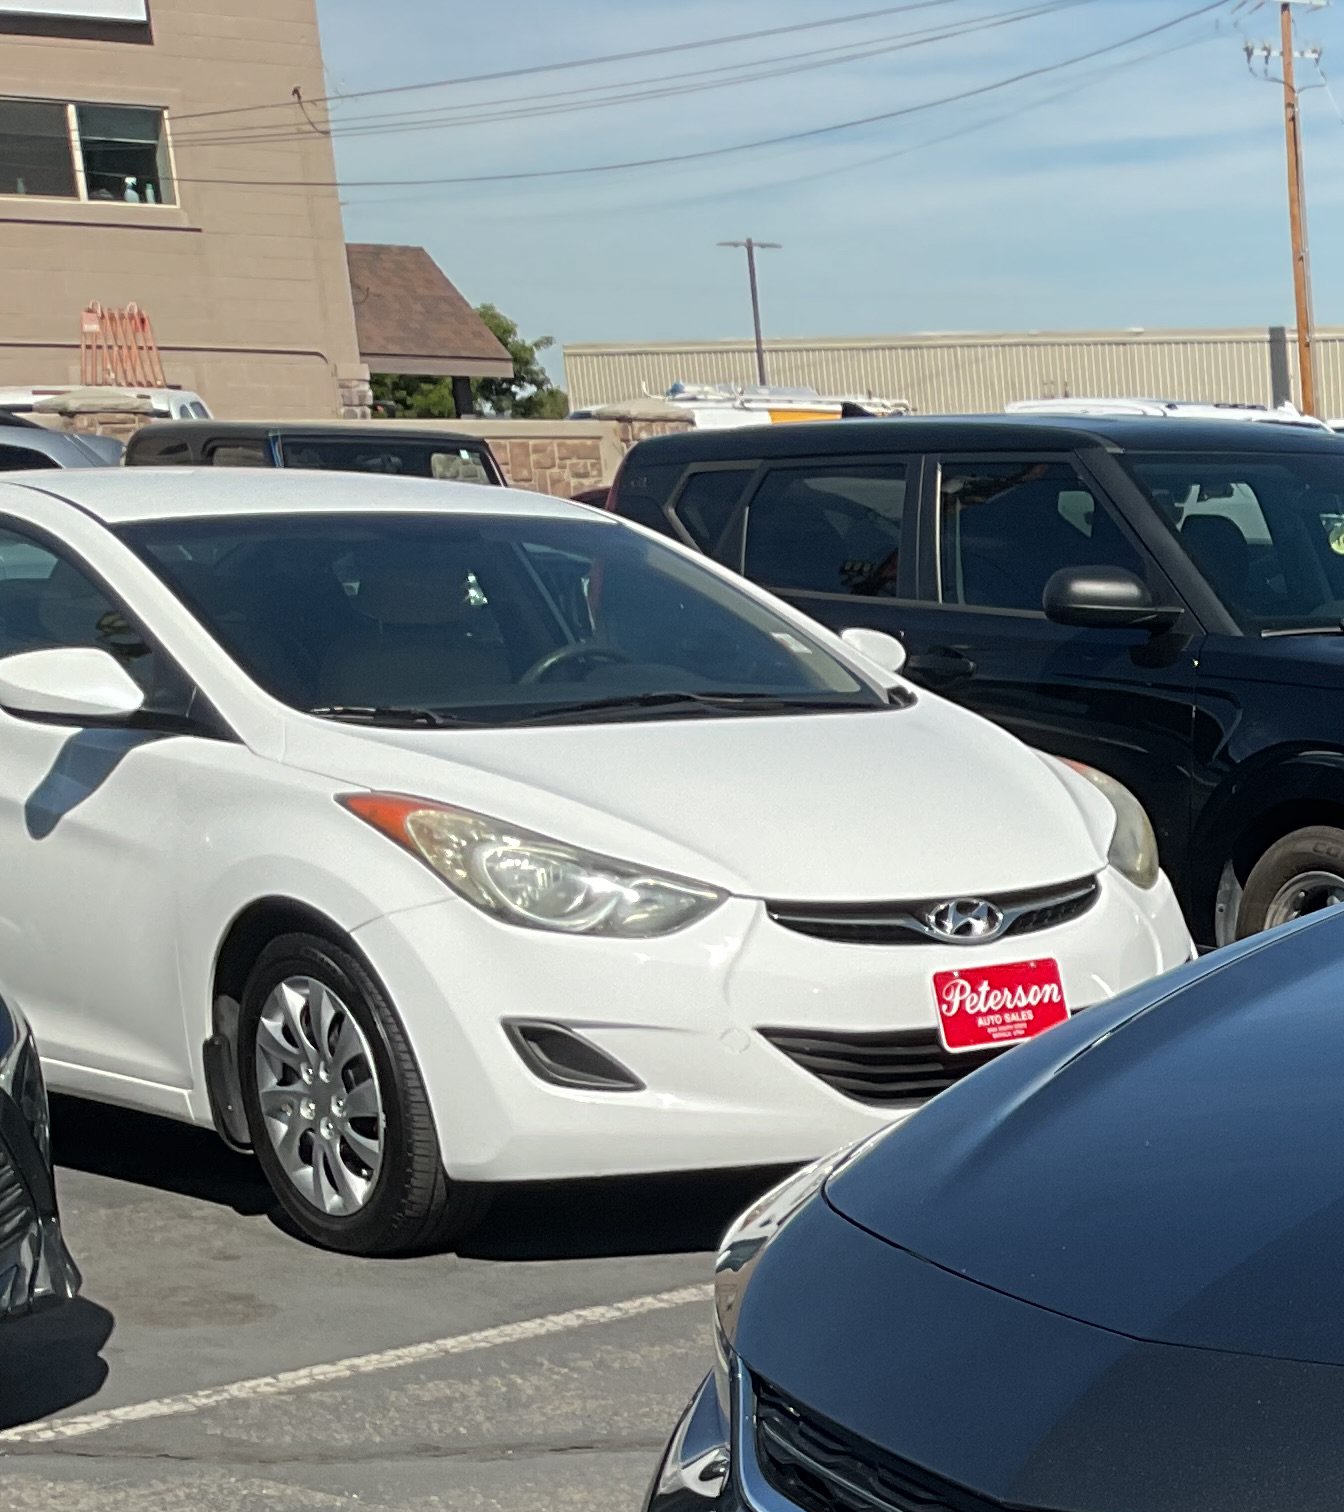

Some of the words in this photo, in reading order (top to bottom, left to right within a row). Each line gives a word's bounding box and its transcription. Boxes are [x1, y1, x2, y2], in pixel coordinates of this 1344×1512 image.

[942, 978, 1062, 1017] Peterson
[977, 1014, 1003, 1028] AUTO
[1004, 1010, 1034, 1023] SALES
